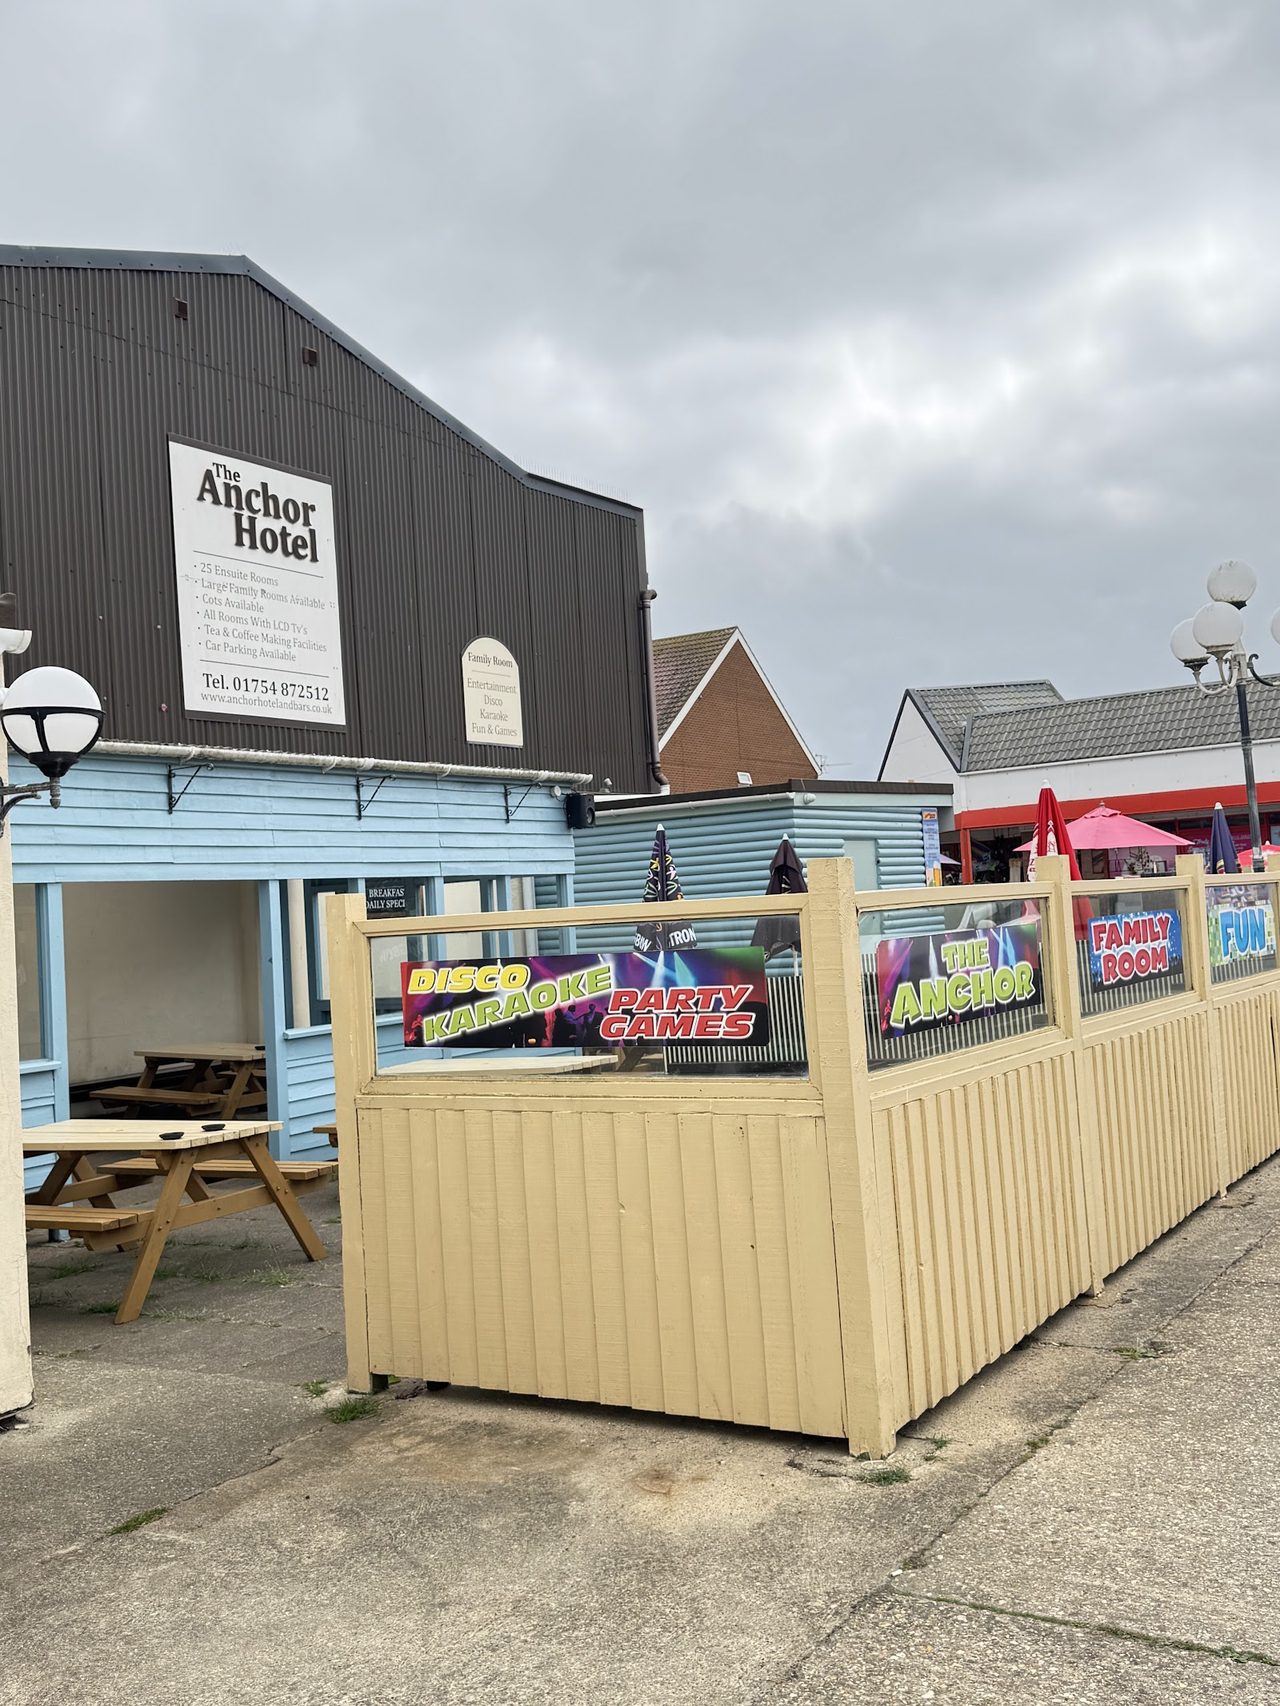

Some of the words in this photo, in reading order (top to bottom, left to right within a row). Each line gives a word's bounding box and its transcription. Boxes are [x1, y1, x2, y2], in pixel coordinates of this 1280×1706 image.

[212, 462, 241, 483] The
[196, 469, 316, 527] Anchor
[233, 512, 319, 563] Hotel
[200, 562, 212, 574] 25
[215, 565, 248, 580] Ensuite
[250, 571, 279, 586] Rooms
[201, 578, 228, 593] Large
[229, 582, 258, 599] Family
[260, 588, 288, 603] Rooms
[290, 594, 326, 609] Available
[202, 593, 222, 606] Cots
[224, 597, 264, 613] Available
[203, 609, 216, 620] All
[218, 611, 249, 625] Rooms
[250, 616, 271, 629] With
[273, 620, 290, 632] LCD
[203, 623, 221, 636] Tea
[222, 626, 230, 638] &
[231, 628, 259, 641] Coffee
[261, 632, 292, 650] Making
[293, 637, 327, 652] Facilities
[205, 640, 221, 651] Car
[223, 641, 258, 659] Parking
[259, 647, 296, 662] Available
[467, 652, 492, 667] Family
[493, 655, 513, 668] Room
[202, 673, 229, 690] Tel.
[233, 676, 278, 695] 01754
[281, 682, 329, 701] 872512
[467, 677, 517, 694] Entertainment
[200, 692, 333, 714] www.anchorhotelandbars.co.uk
[484, 694, 503, 707] Disco
[480, 708, 509, 722] Karaoke
[472, 722, 486, 734] Fun
[487, 724, 493, 735] &
[494, 725, 518, 737] Games
[368, 888, 405, 898] BREAKFAS
[1091, 913, 1171, 954] FAMILY
[1219, 906, 1267, 960] FUN
[940, 936, 991, 974] THE
[1101, 945, 1169, 986] ROOM
[407, 964, 531, 995] DISCO
[422, 964, 613, 1045] KARAOKE
[607, 984, 754, 1014] PARTY
[889, 961, 1036, 1028] ANCHOR
[599, 1012, 757, 1040] GAMES
